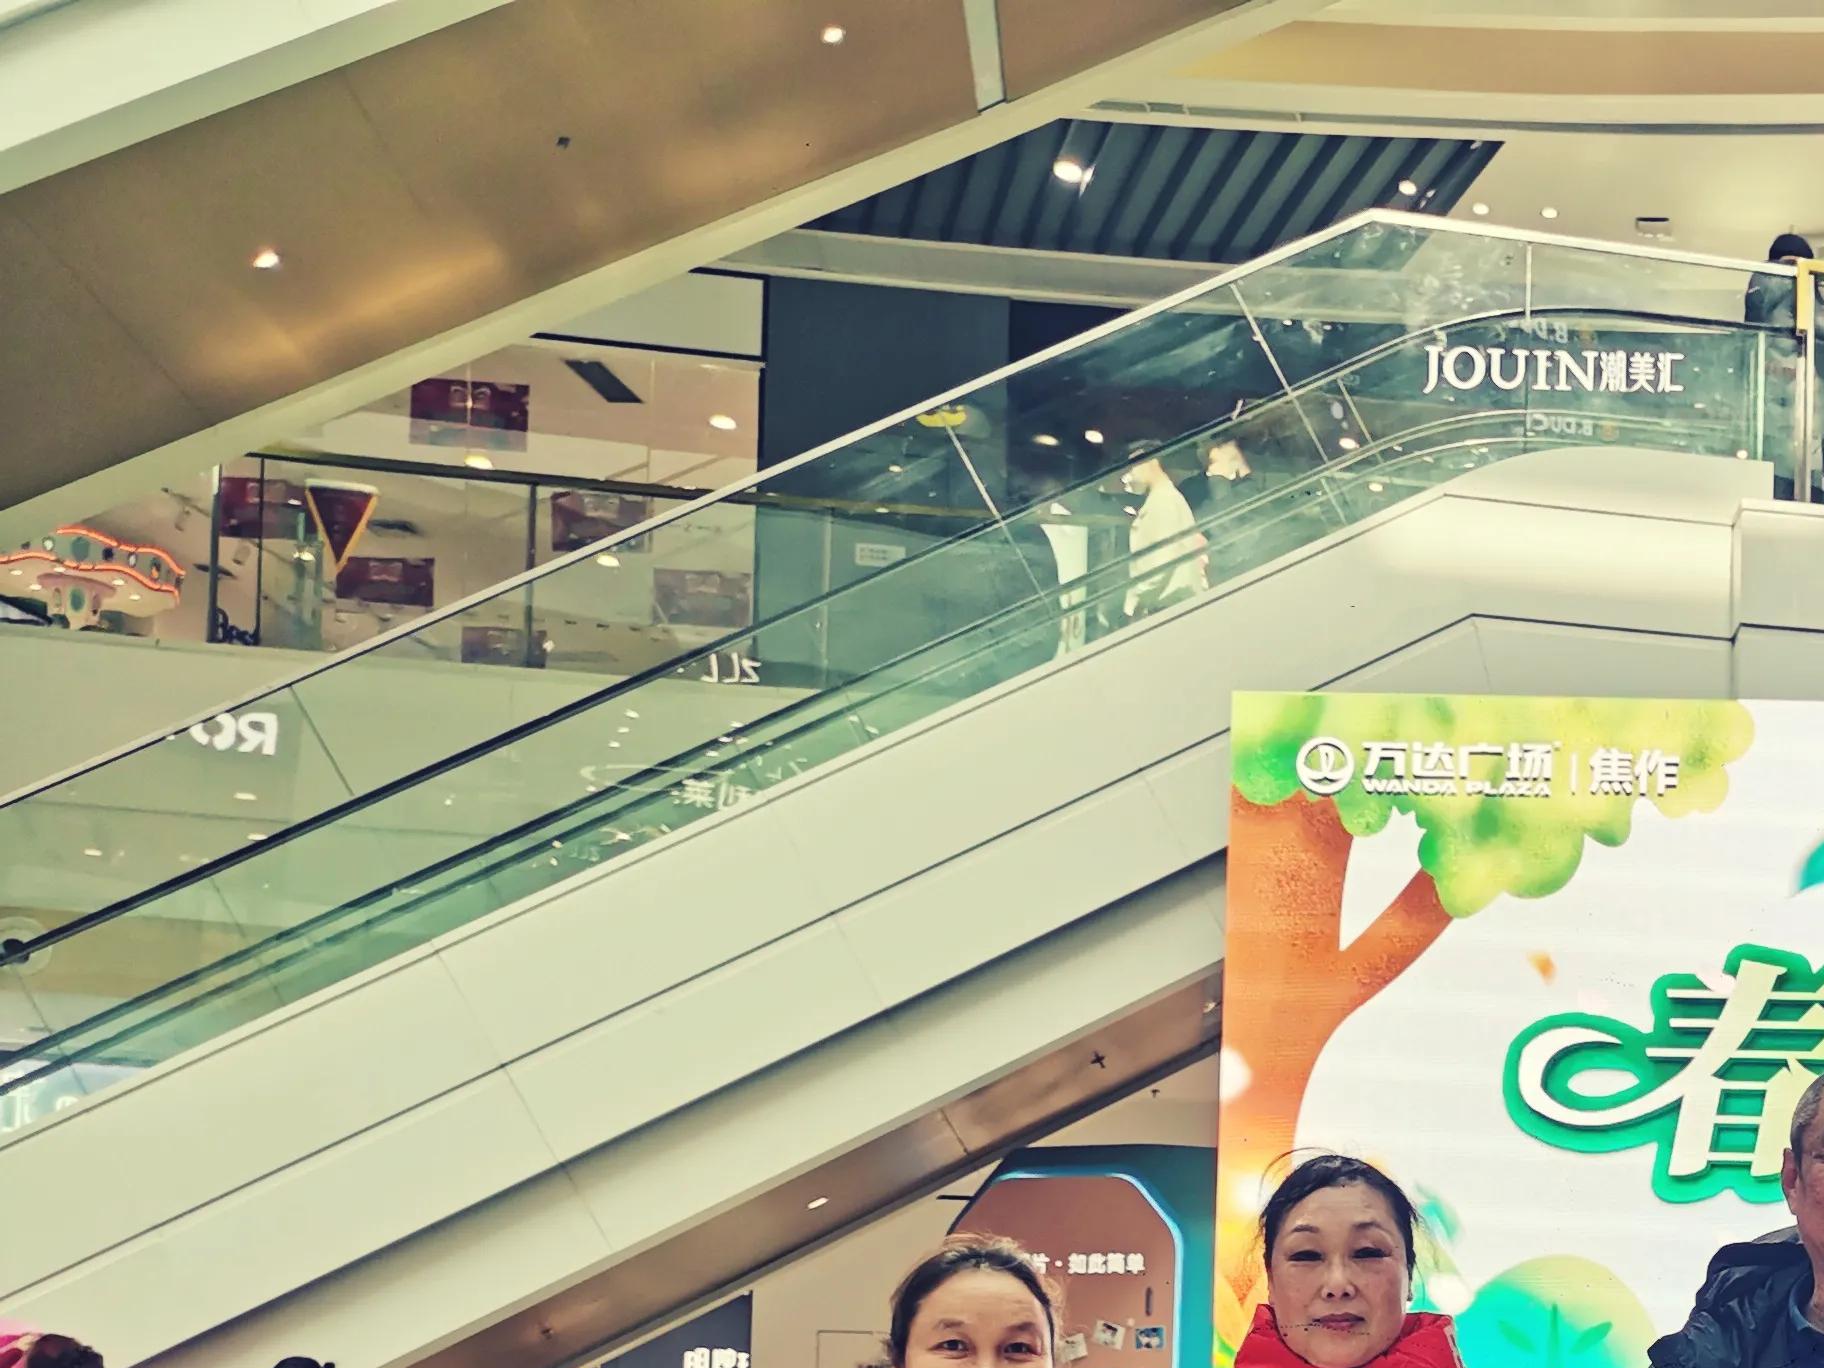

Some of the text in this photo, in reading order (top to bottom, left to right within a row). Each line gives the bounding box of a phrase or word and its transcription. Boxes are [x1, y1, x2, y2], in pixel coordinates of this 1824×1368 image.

[1422, 345, 1685, 394] JOUIN 潮美汇
[1361, 741, 1680, 797] 万达广场 焦作
[1363, 778, 1552, 798] WANDA PLAZA
